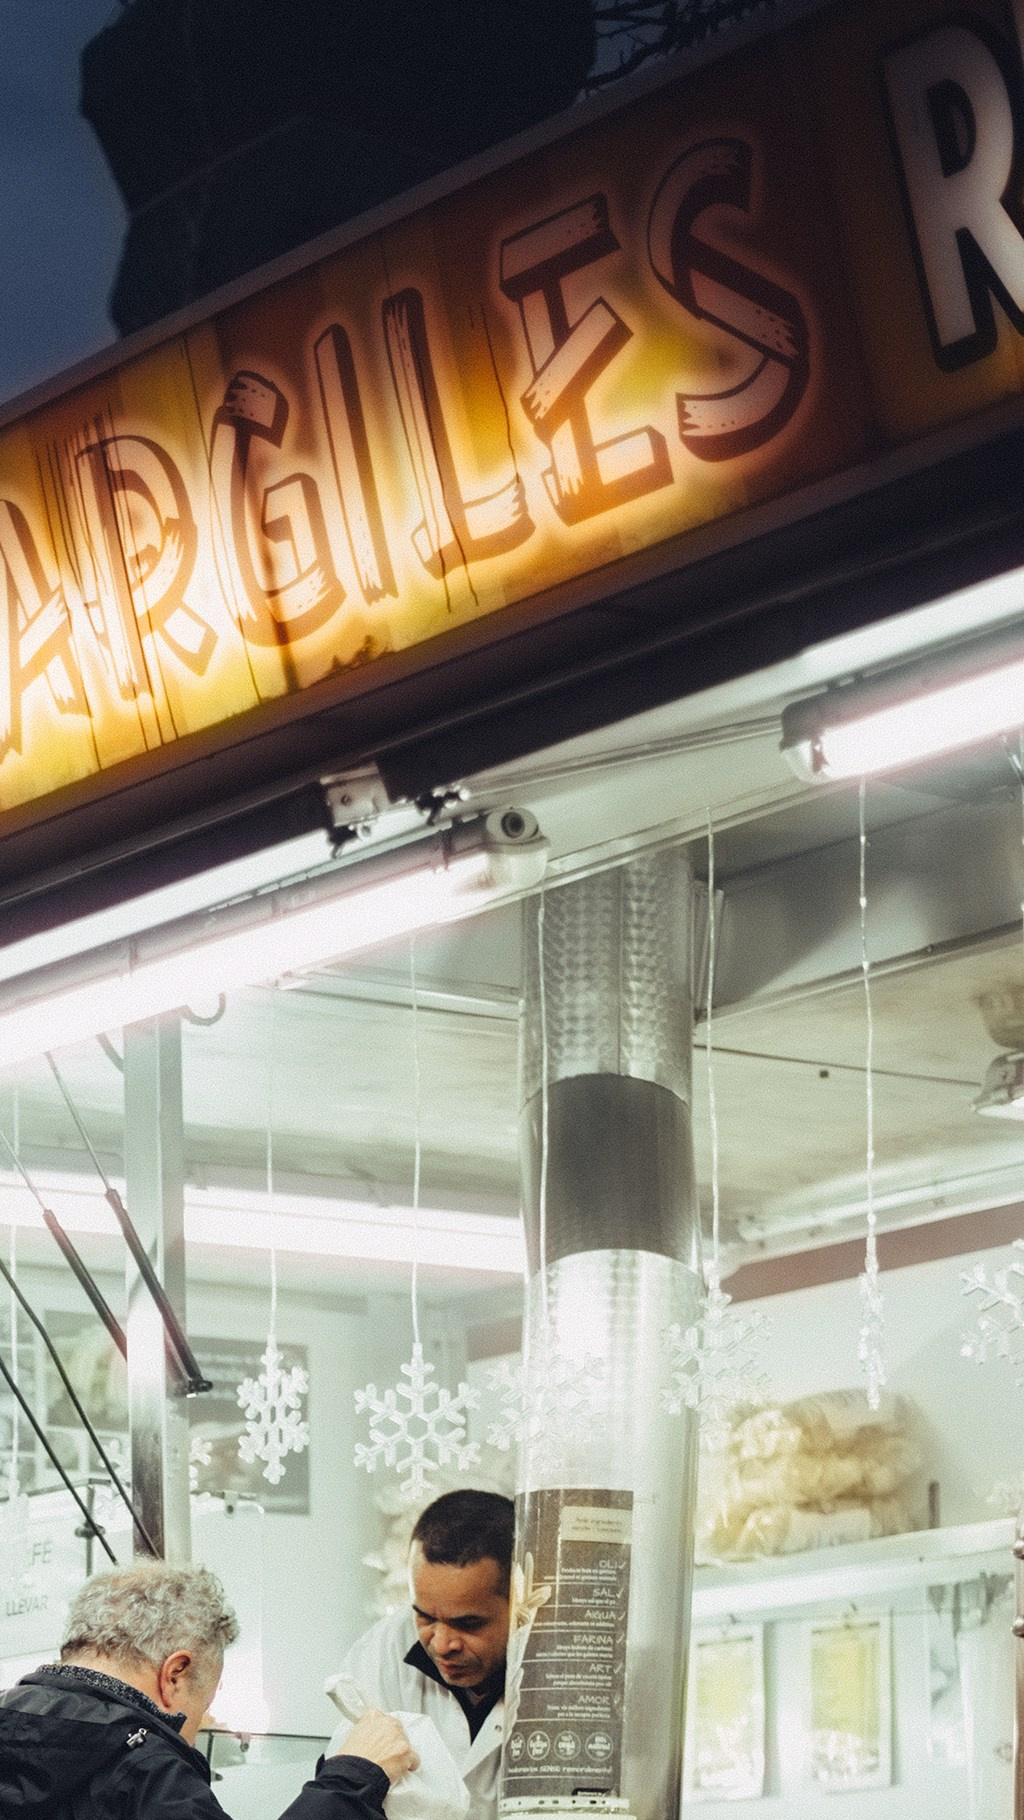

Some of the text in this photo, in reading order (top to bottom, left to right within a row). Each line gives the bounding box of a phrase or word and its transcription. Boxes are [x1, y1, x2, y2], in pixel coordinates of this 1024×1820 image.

[592, 1586, 616, 1598] SAL
[573, 1634, 613, 1645] FARINA
[589, 1662, 612, 1674] ART
[578, 1694, 611, 1706] AMOR
